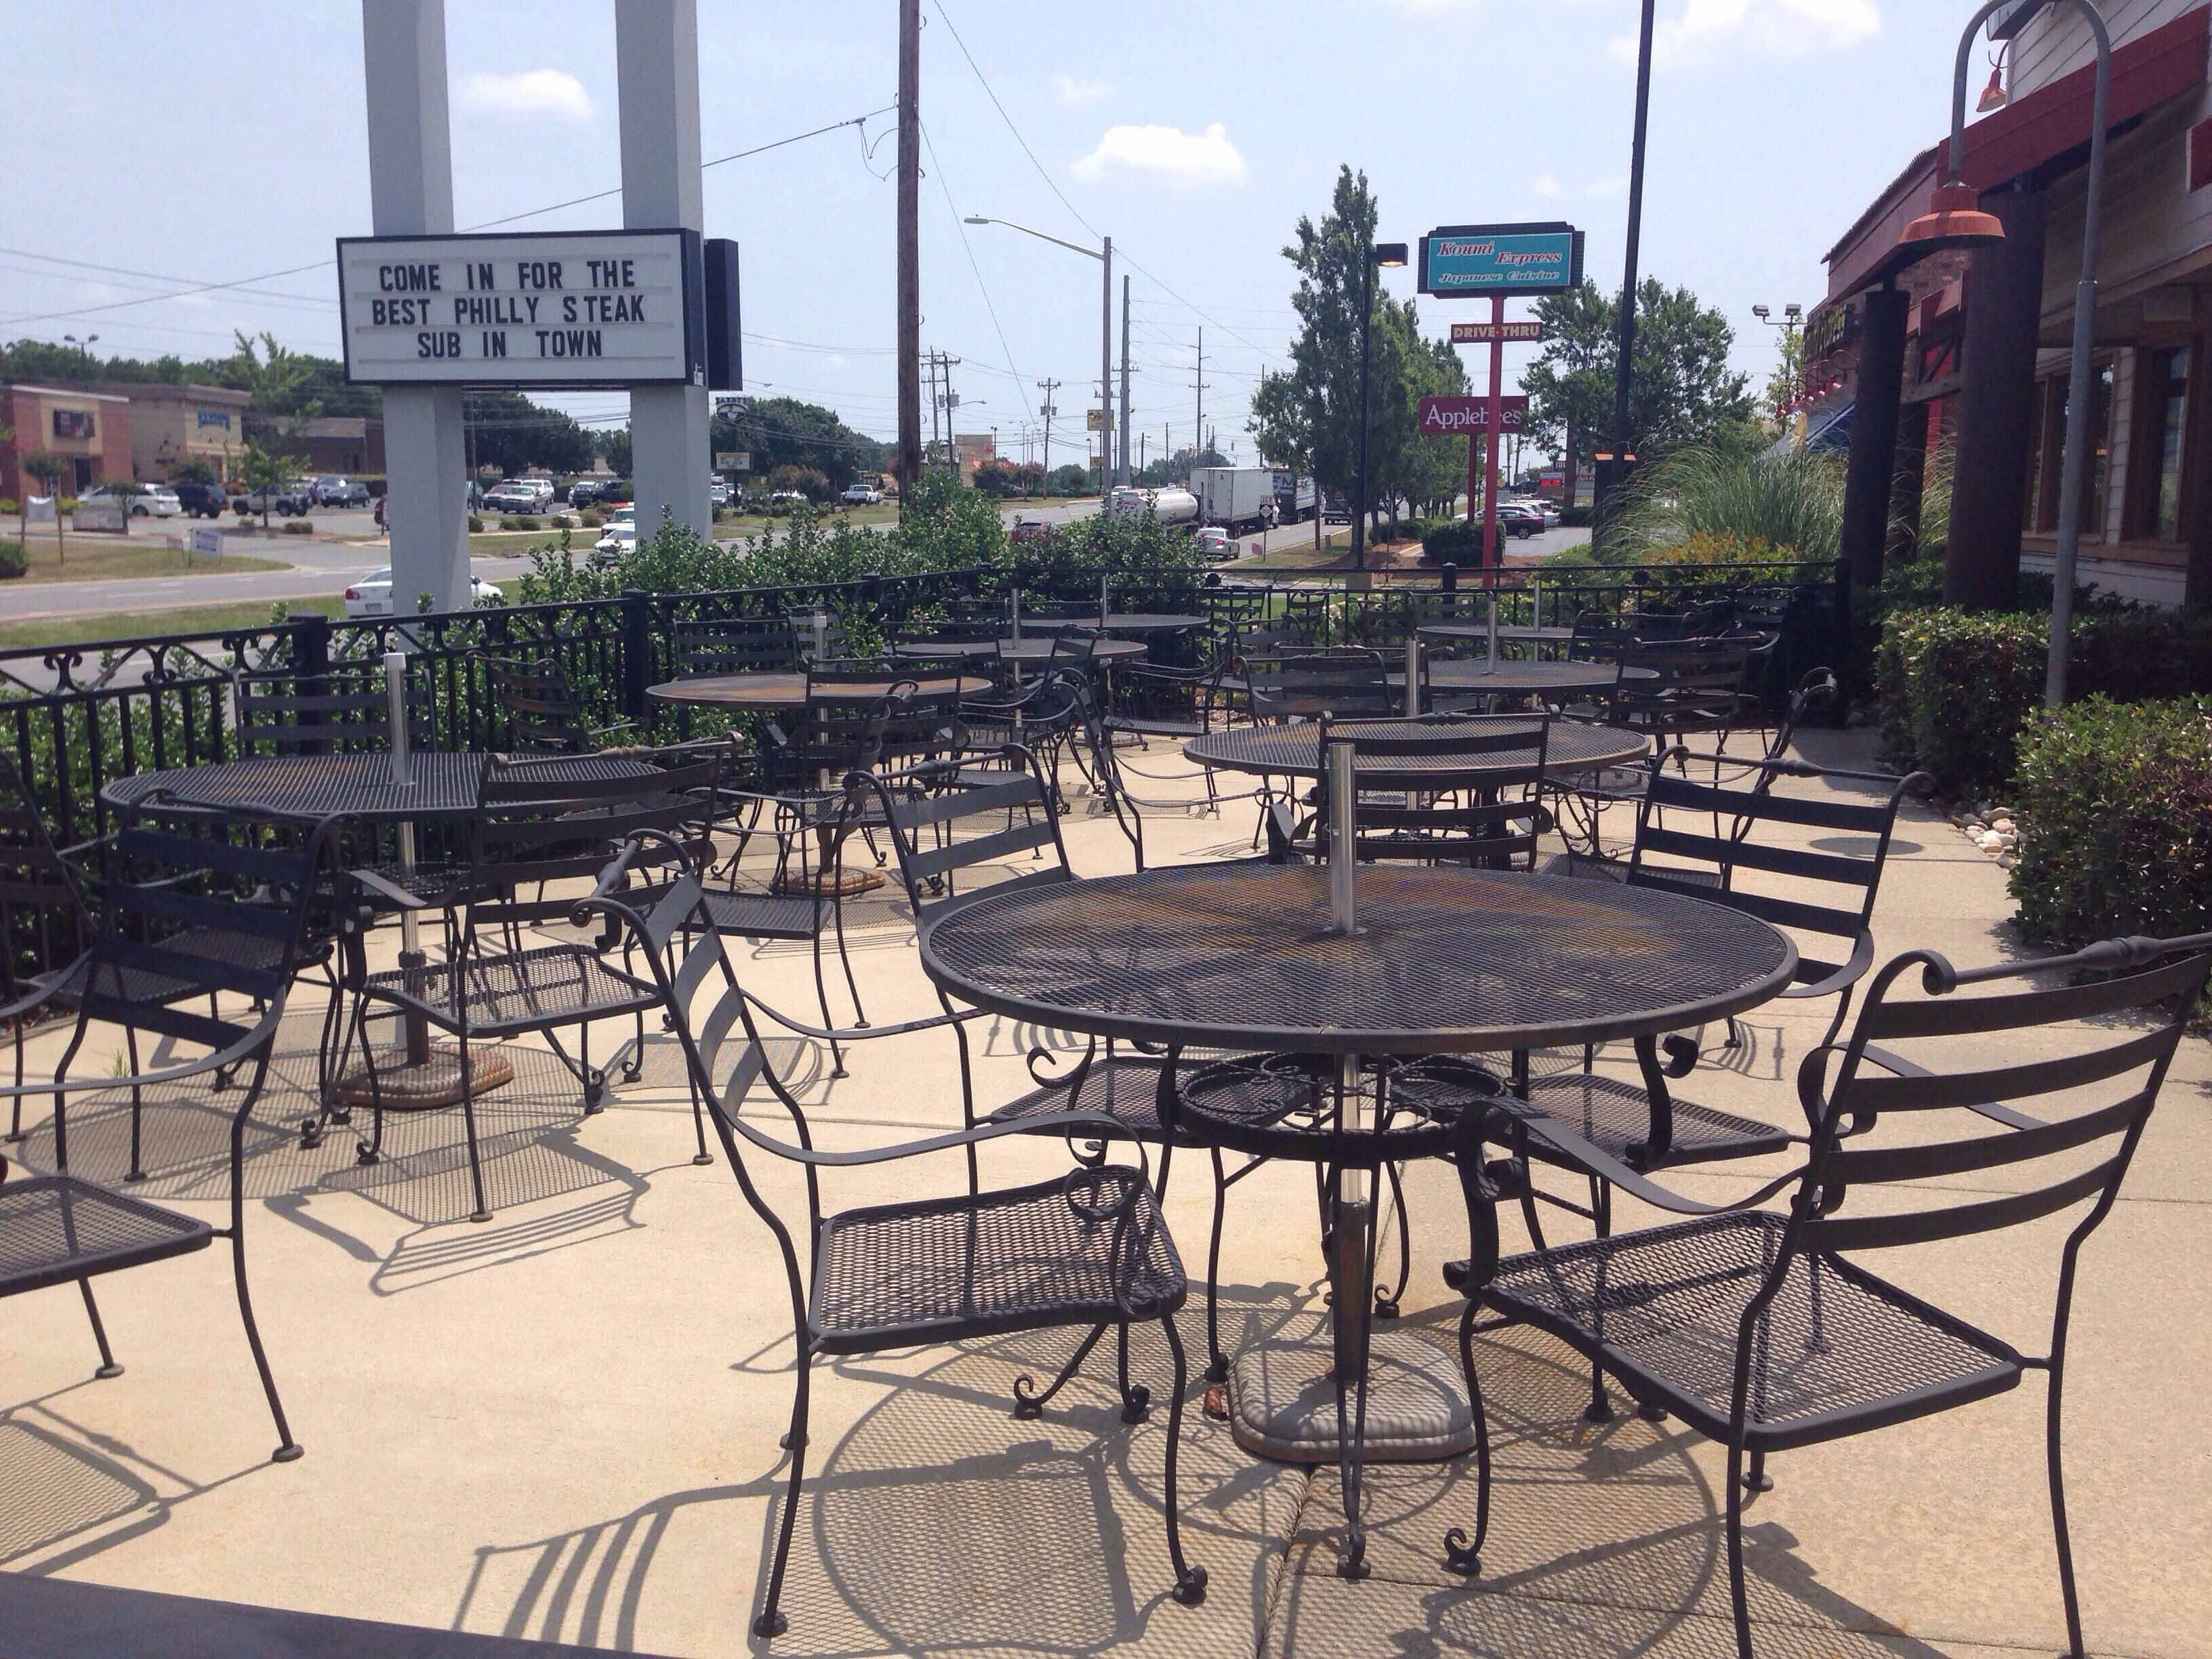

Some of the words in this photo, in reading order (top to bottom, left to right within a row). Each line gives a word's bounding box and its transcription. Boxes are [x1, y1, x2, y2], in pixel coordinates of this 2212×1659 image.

[1495, 251, 1563, 266] Express
[379, 264, 441, 292] COME
[466, 263, 494, 291] IN
[517, 261, 563, 289] FOR
[586, 260, 635, 288] THE
[1438, 272, 1503, 284] Japanese
[1507, 270, 1560, 281] Cuisine
[371, 298, 431, 325] BEST
[454, 296, 539, 325] PHILLY
[562, 294, 645, 323] STEAK
[417, 331, 462, 359] SUB
[482, 331, 507, 358] IN
[535, 329, 602, 358] TOWN
